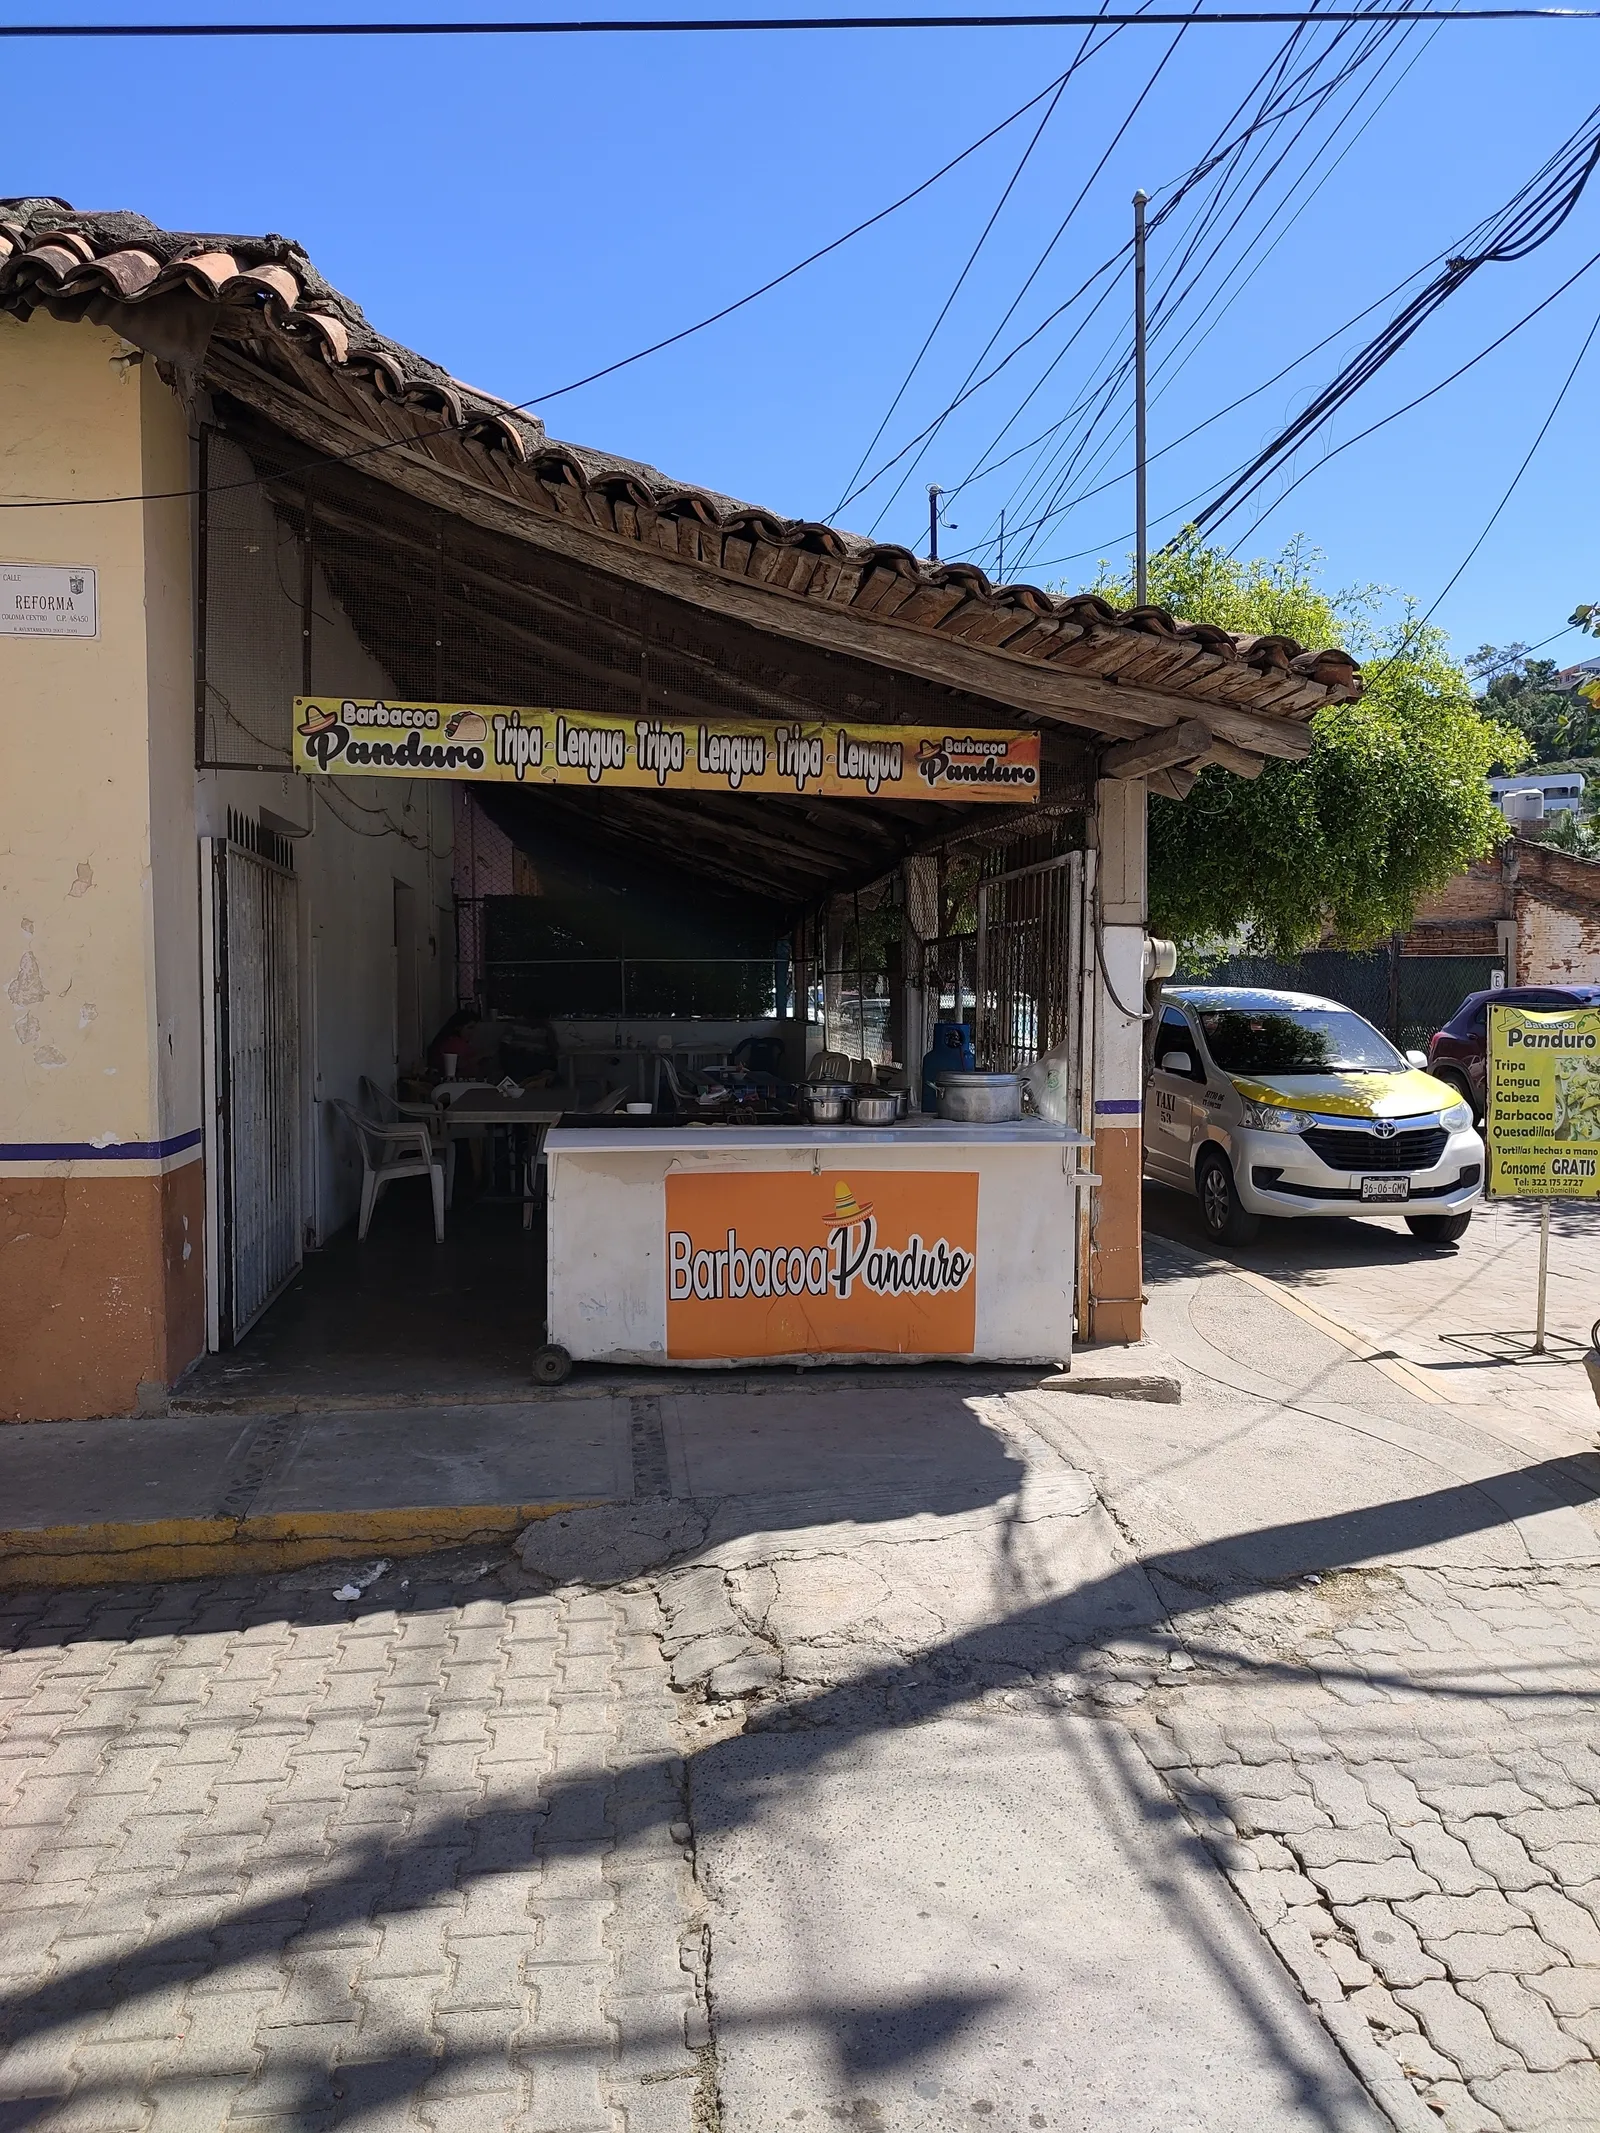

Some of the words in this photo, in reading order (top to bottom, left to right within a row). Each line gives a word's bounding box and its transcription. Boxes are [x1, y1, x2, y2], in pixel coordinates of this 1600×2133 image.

[2, 574, 21, 582] CALLE
[15, 595, 74, 611] REFORMA
[1, 613, 25, 621] COLONIA
[25, 614, 48, 622] CENTRO
[341, 701, 440, 729] Barbacoa
[305, 725, 485, 773] Panduro
[492, 710, 543, 780] Tripa
[556, 716, 626, 783] Lengua
[635, 720, 685, 786] Tripa
[698, 724, 765, 790] Lengua
[775, 724, 823, 791] Tripa
[837, 728, 903, 794] Lengua
[944, 737, 1007, 755] Barbacoa
[919, 751, 1037, 786] Panduro
[1508, 1029, 1597, 1049] Panduro
[1494, 1059, 1526, 1073] Tripa
[1496, 1076, 1540, 1088] Lengua
[1156, 1090, 1176, 1112] TAXI
[1496, 1091, 1540, 1103] Cabeza
[1160, 1110, 1172, 1124] 53
[1494, 1110, 1553, 1121] Barbacoa
[1493, 1126, 1554, 1139] Quesadillas
[1496, 1146, 1531, 1154] Tortillas
[1534, 1146, 1563, 1154] hechas
[1573, 1148, 1598, 1156] mano
[1500, 1161, 1546, 1175] Consomé
[1552, 1158, 1596, 1176] GRATIS
[1514, 1178, 1529, 1186] Tel:
[1532, 1178, 1548, 1186] 322
[1550, 1178, 1561, 1186] 175
[1562, 1178, 1584, 1187] 2727
[668, 1228, 828, 1300] Barbacoa
[829, 1215, 973, 1297] Panduro
